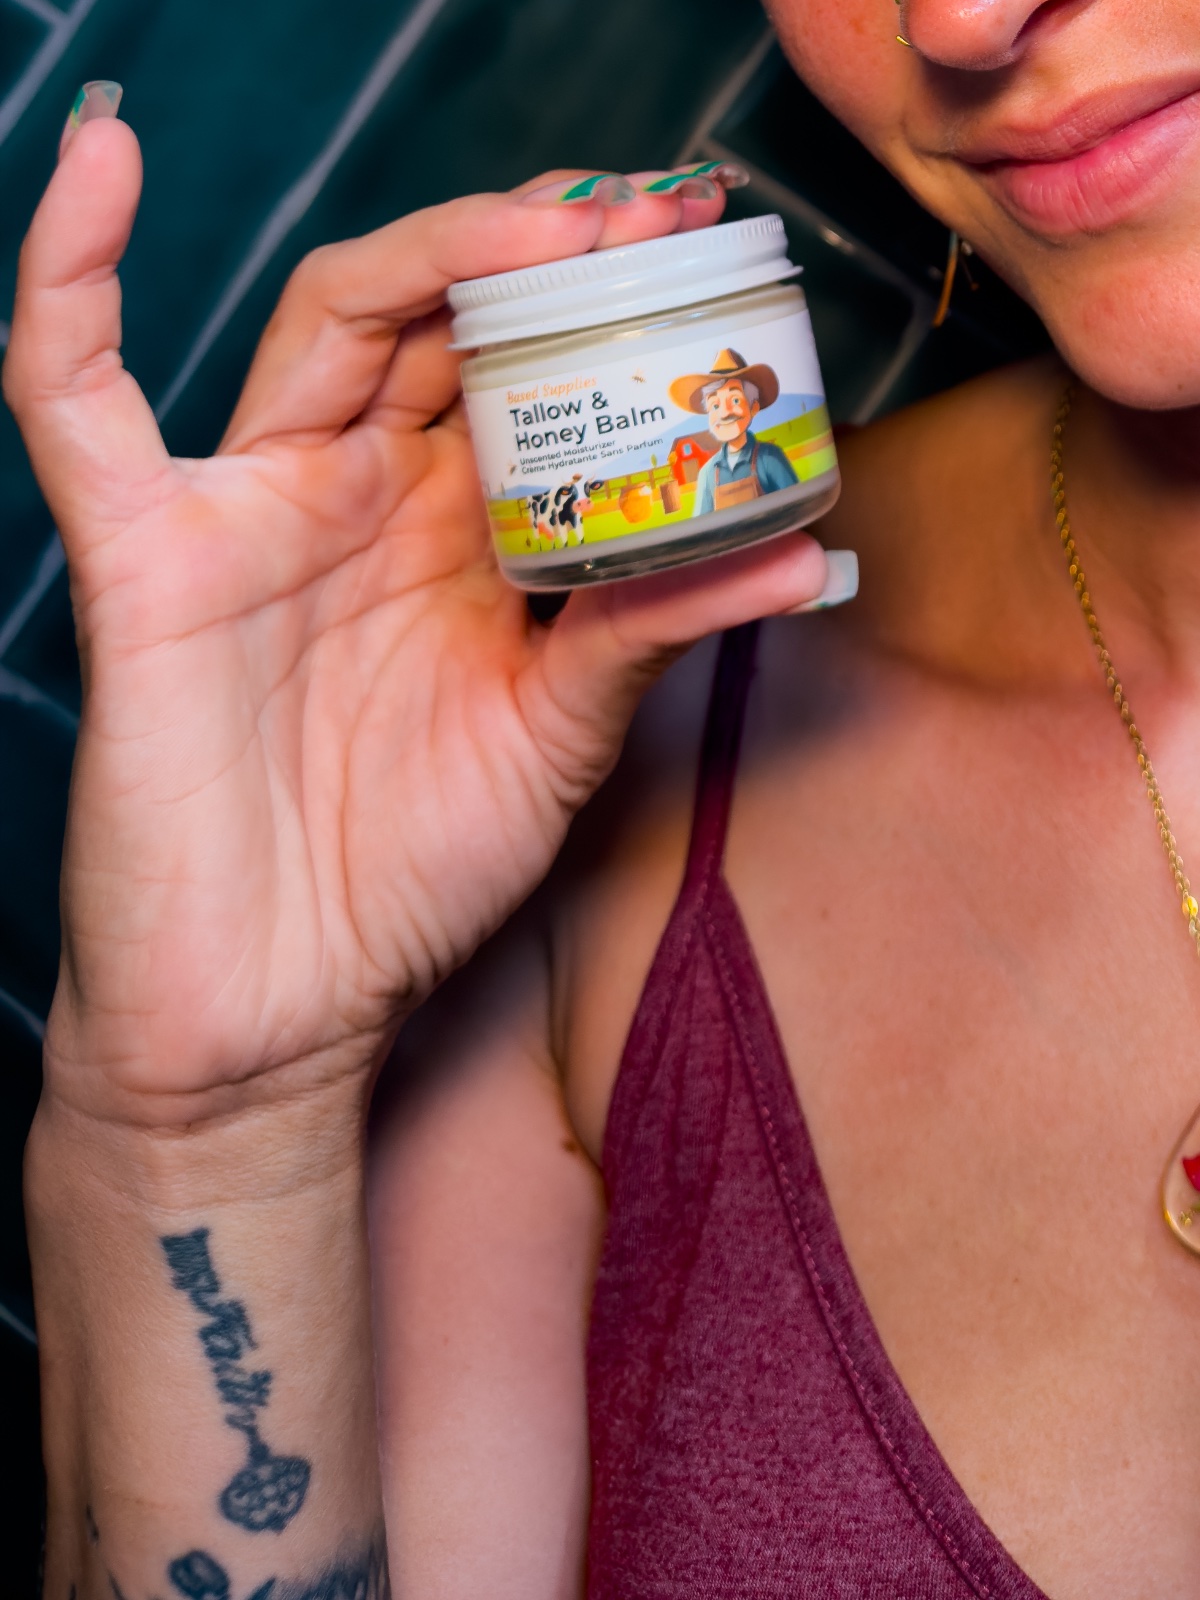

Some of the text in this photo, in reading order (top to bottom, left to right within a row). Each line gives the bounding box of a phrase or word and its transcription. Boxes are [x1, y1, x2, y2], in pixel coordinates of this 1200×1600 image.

[506, 376, 597, 404] Based Supplies
[510, 391, 609, 427] Tallow &
[515, 406, 665, 451] Honey Balm
[520, 439, 615, 465] Unscented Moisturizer
[548, 453, 597, 470] Hydratante
[601, 448, 624, 458] Sans
[627, 438, 663, 452] Parfum
